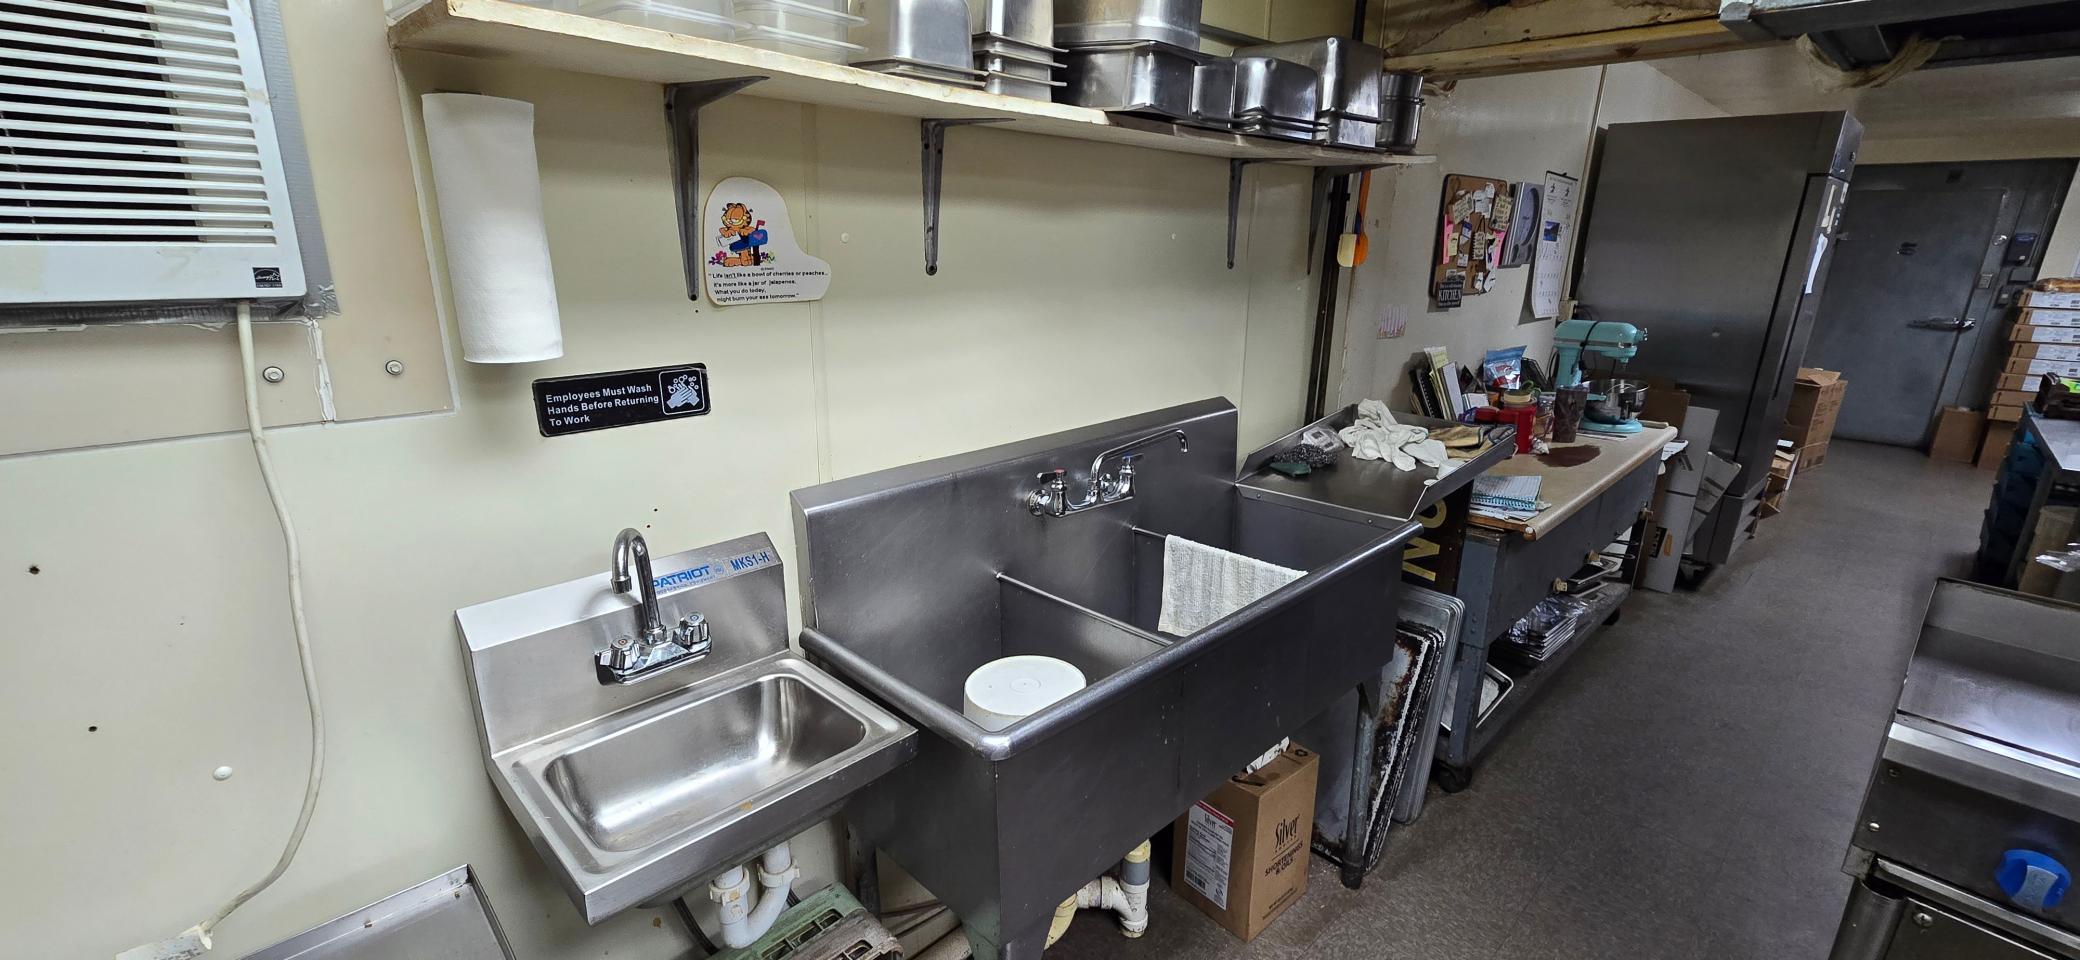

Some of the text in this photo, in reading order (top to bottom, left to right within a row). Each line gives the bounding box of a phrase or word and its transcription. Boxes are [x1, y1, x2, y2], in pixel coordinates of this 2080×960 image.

[546, 384, 652, 404] Employees Must Wash
[547, 395, 659, 415] Hands Before Returning
[549, 414, 590, 427] To Work
[730, 551, 770, 572] MKS1-H
[1274, 814, 1300, 849] Silver
